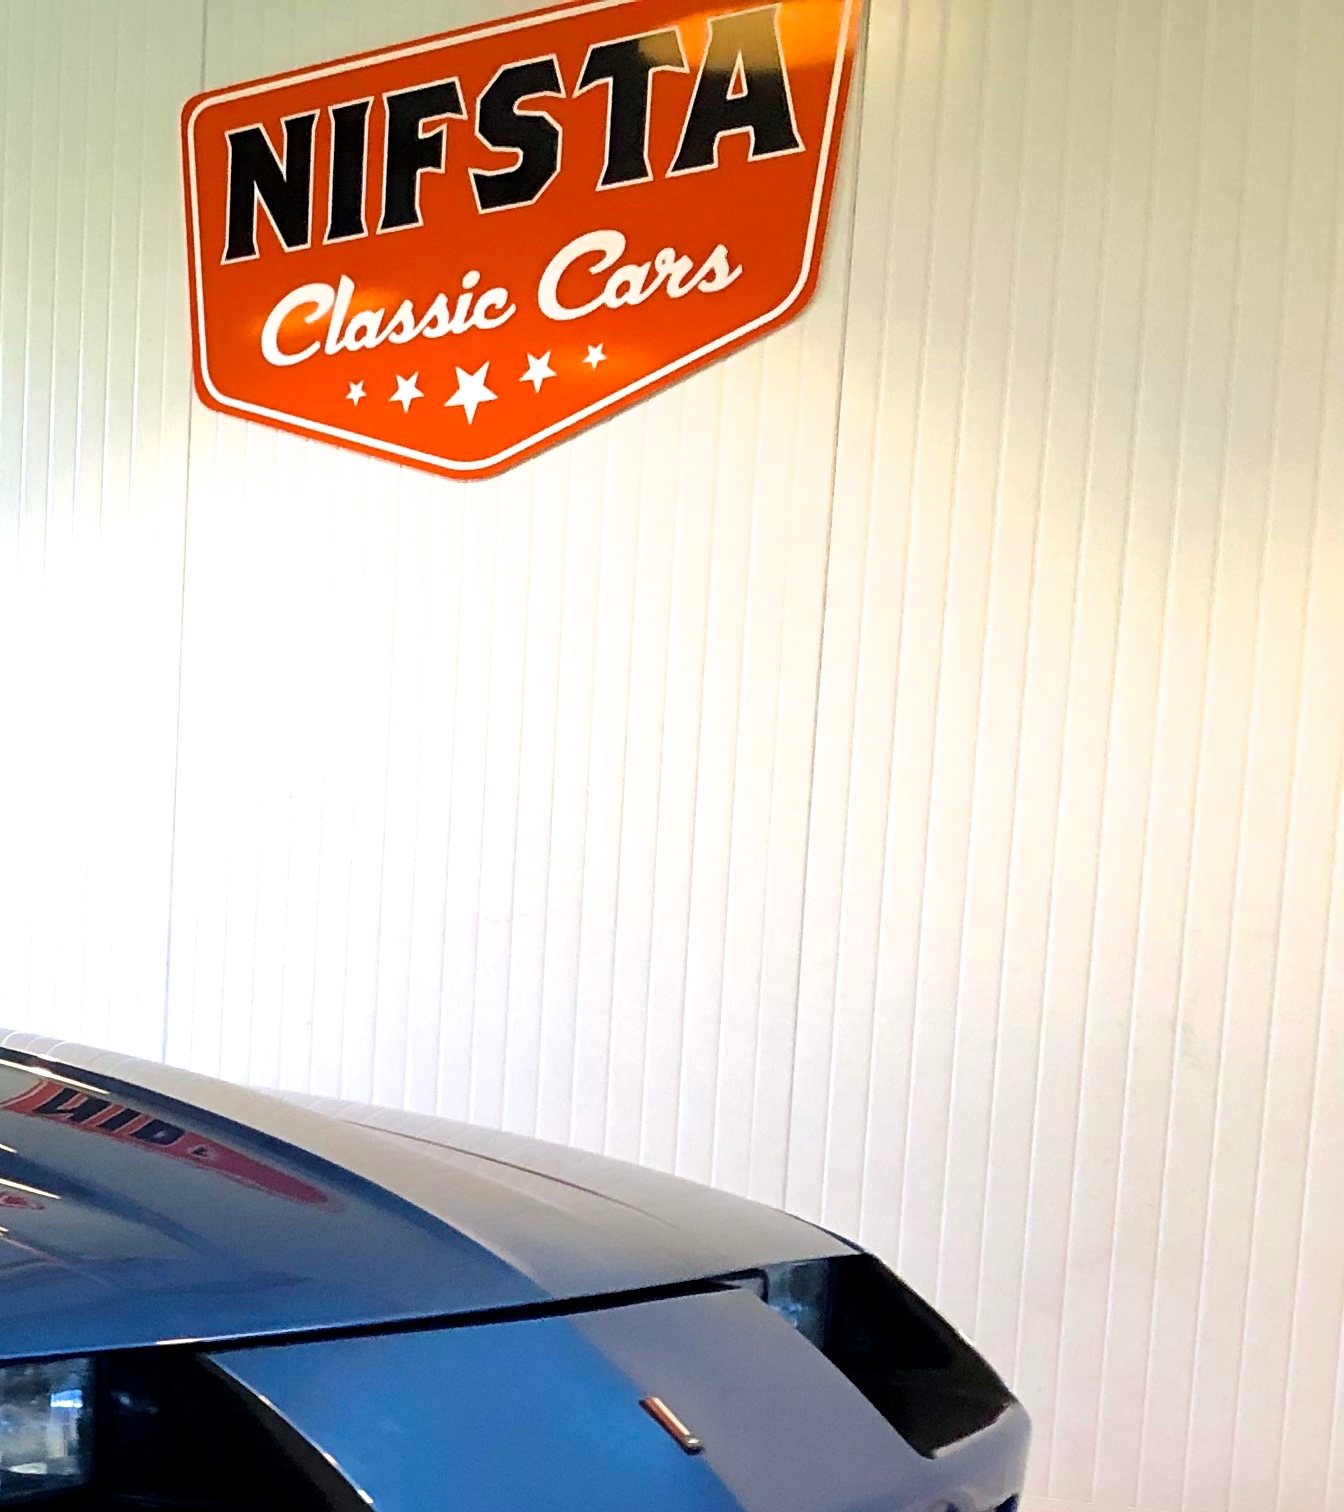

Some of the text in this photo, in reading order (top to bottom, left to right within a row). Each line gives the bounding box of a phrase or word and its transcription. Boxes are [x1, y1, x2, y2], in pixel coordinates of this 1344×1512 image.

[220, 6, 805, 264] NIFSTA
[261, 230, 742, 366] Classic Cars
